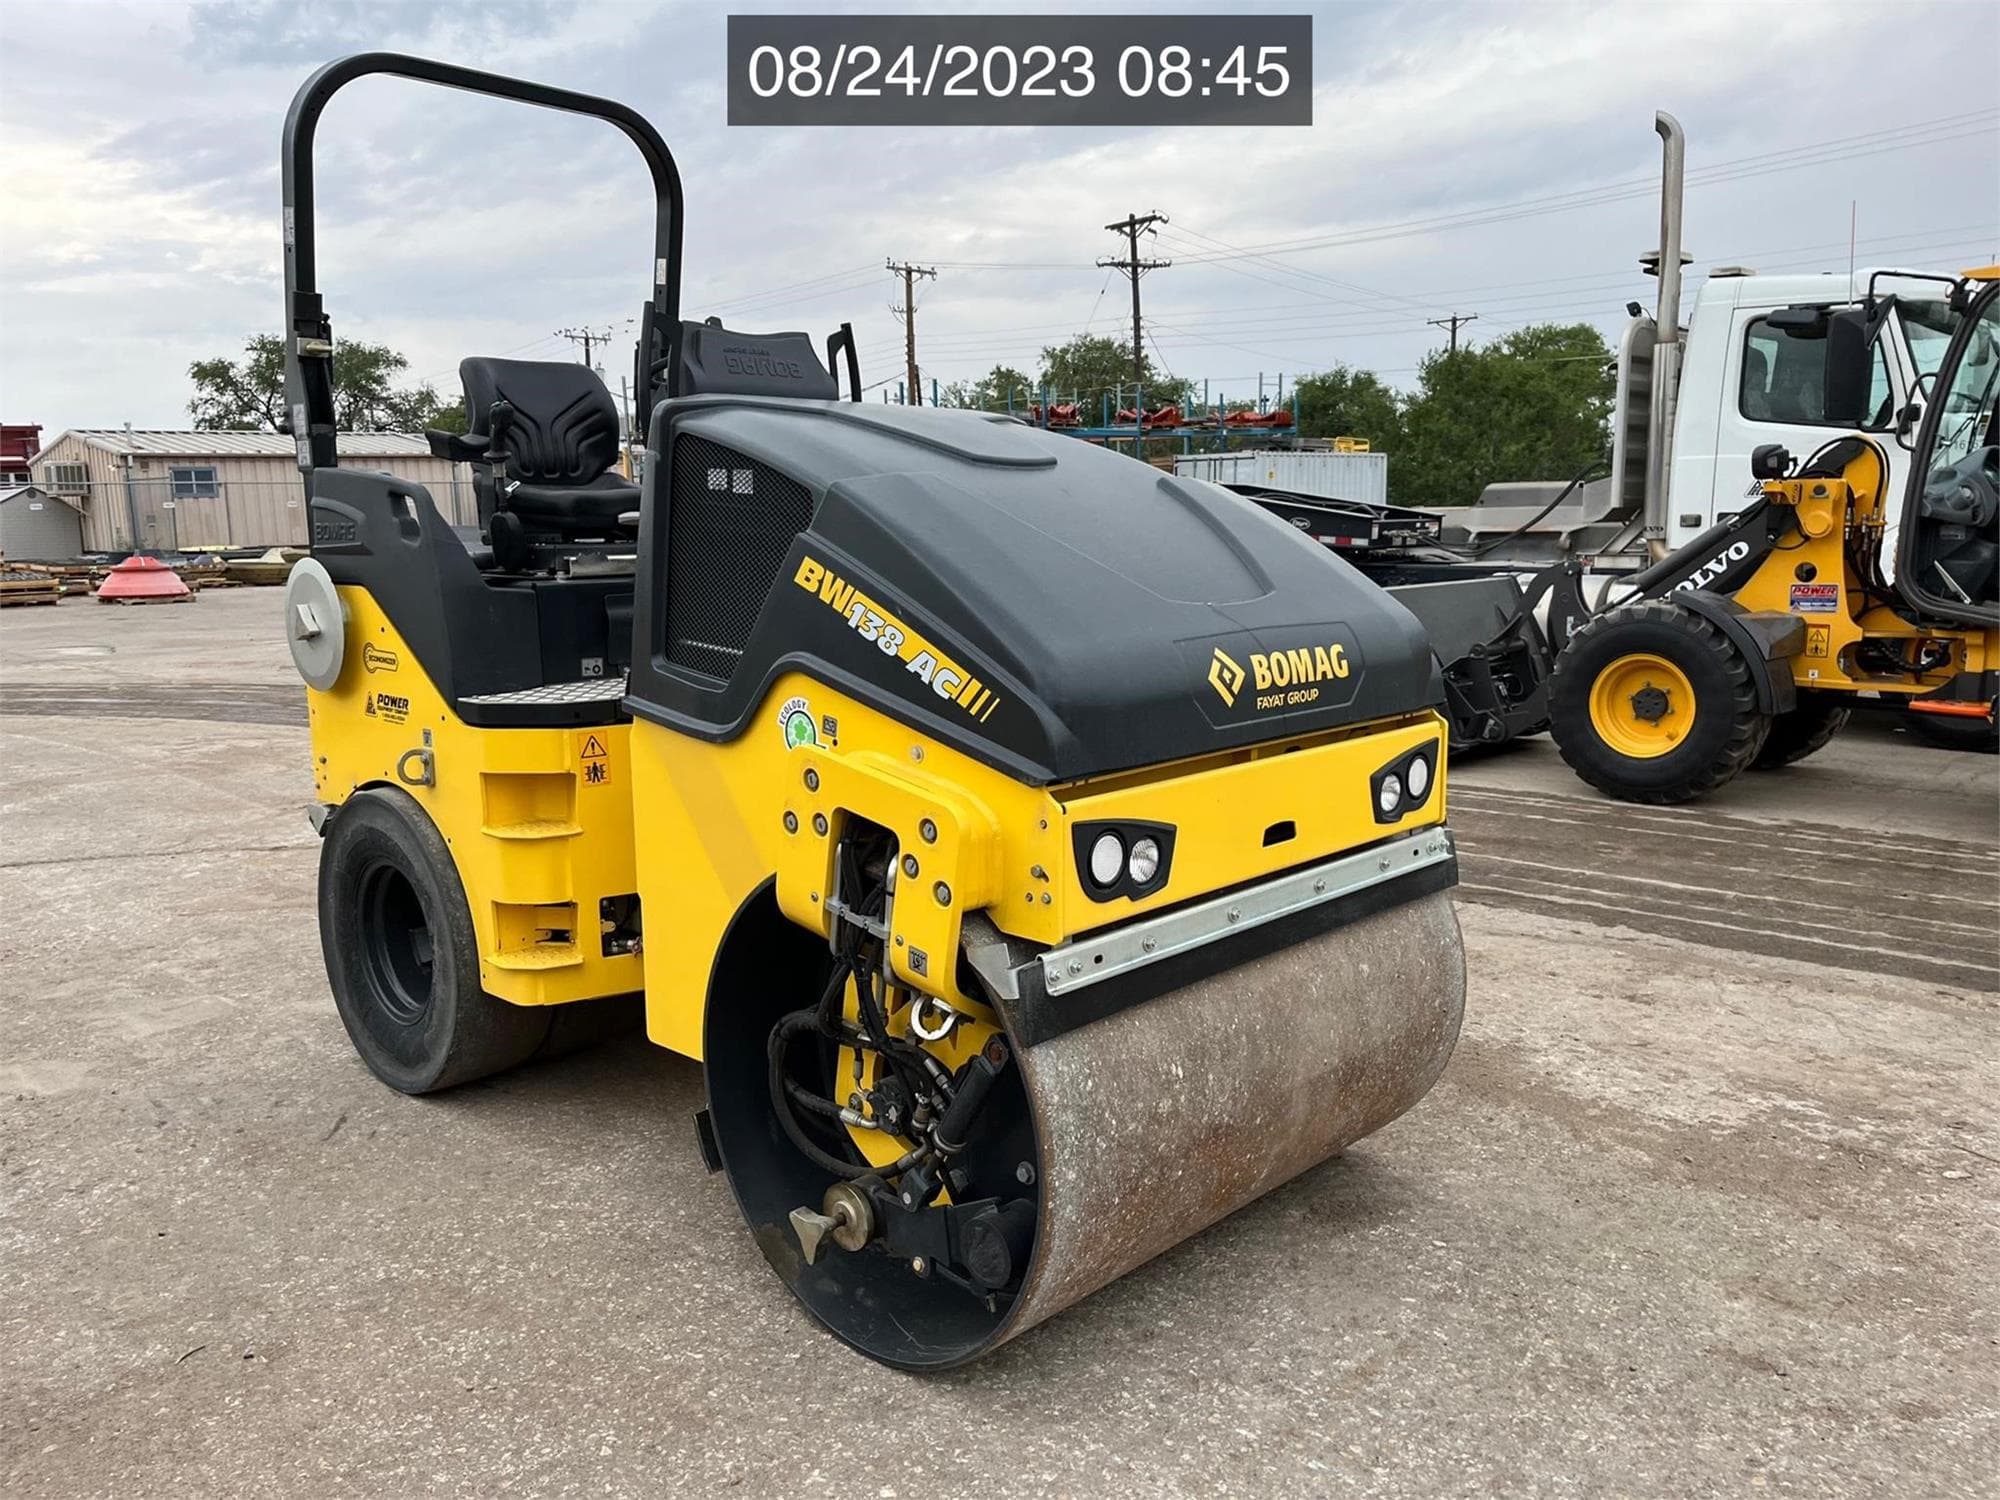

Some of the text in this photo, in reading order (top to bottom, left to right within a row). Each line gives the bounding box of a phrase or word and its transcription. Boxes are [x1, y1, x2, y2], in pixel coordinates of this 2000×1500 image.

[1661, 541, 1750, 600] OLVO
[1792, 586, 1837, 595] POWER
[1249, 643, 1349, 690] BOMAG
[377, 693, 409, 710] POWER
[1256, 688, 1320, 710] FAYAT GROUP
[779, 699, 807, 726] ECOLOGY
